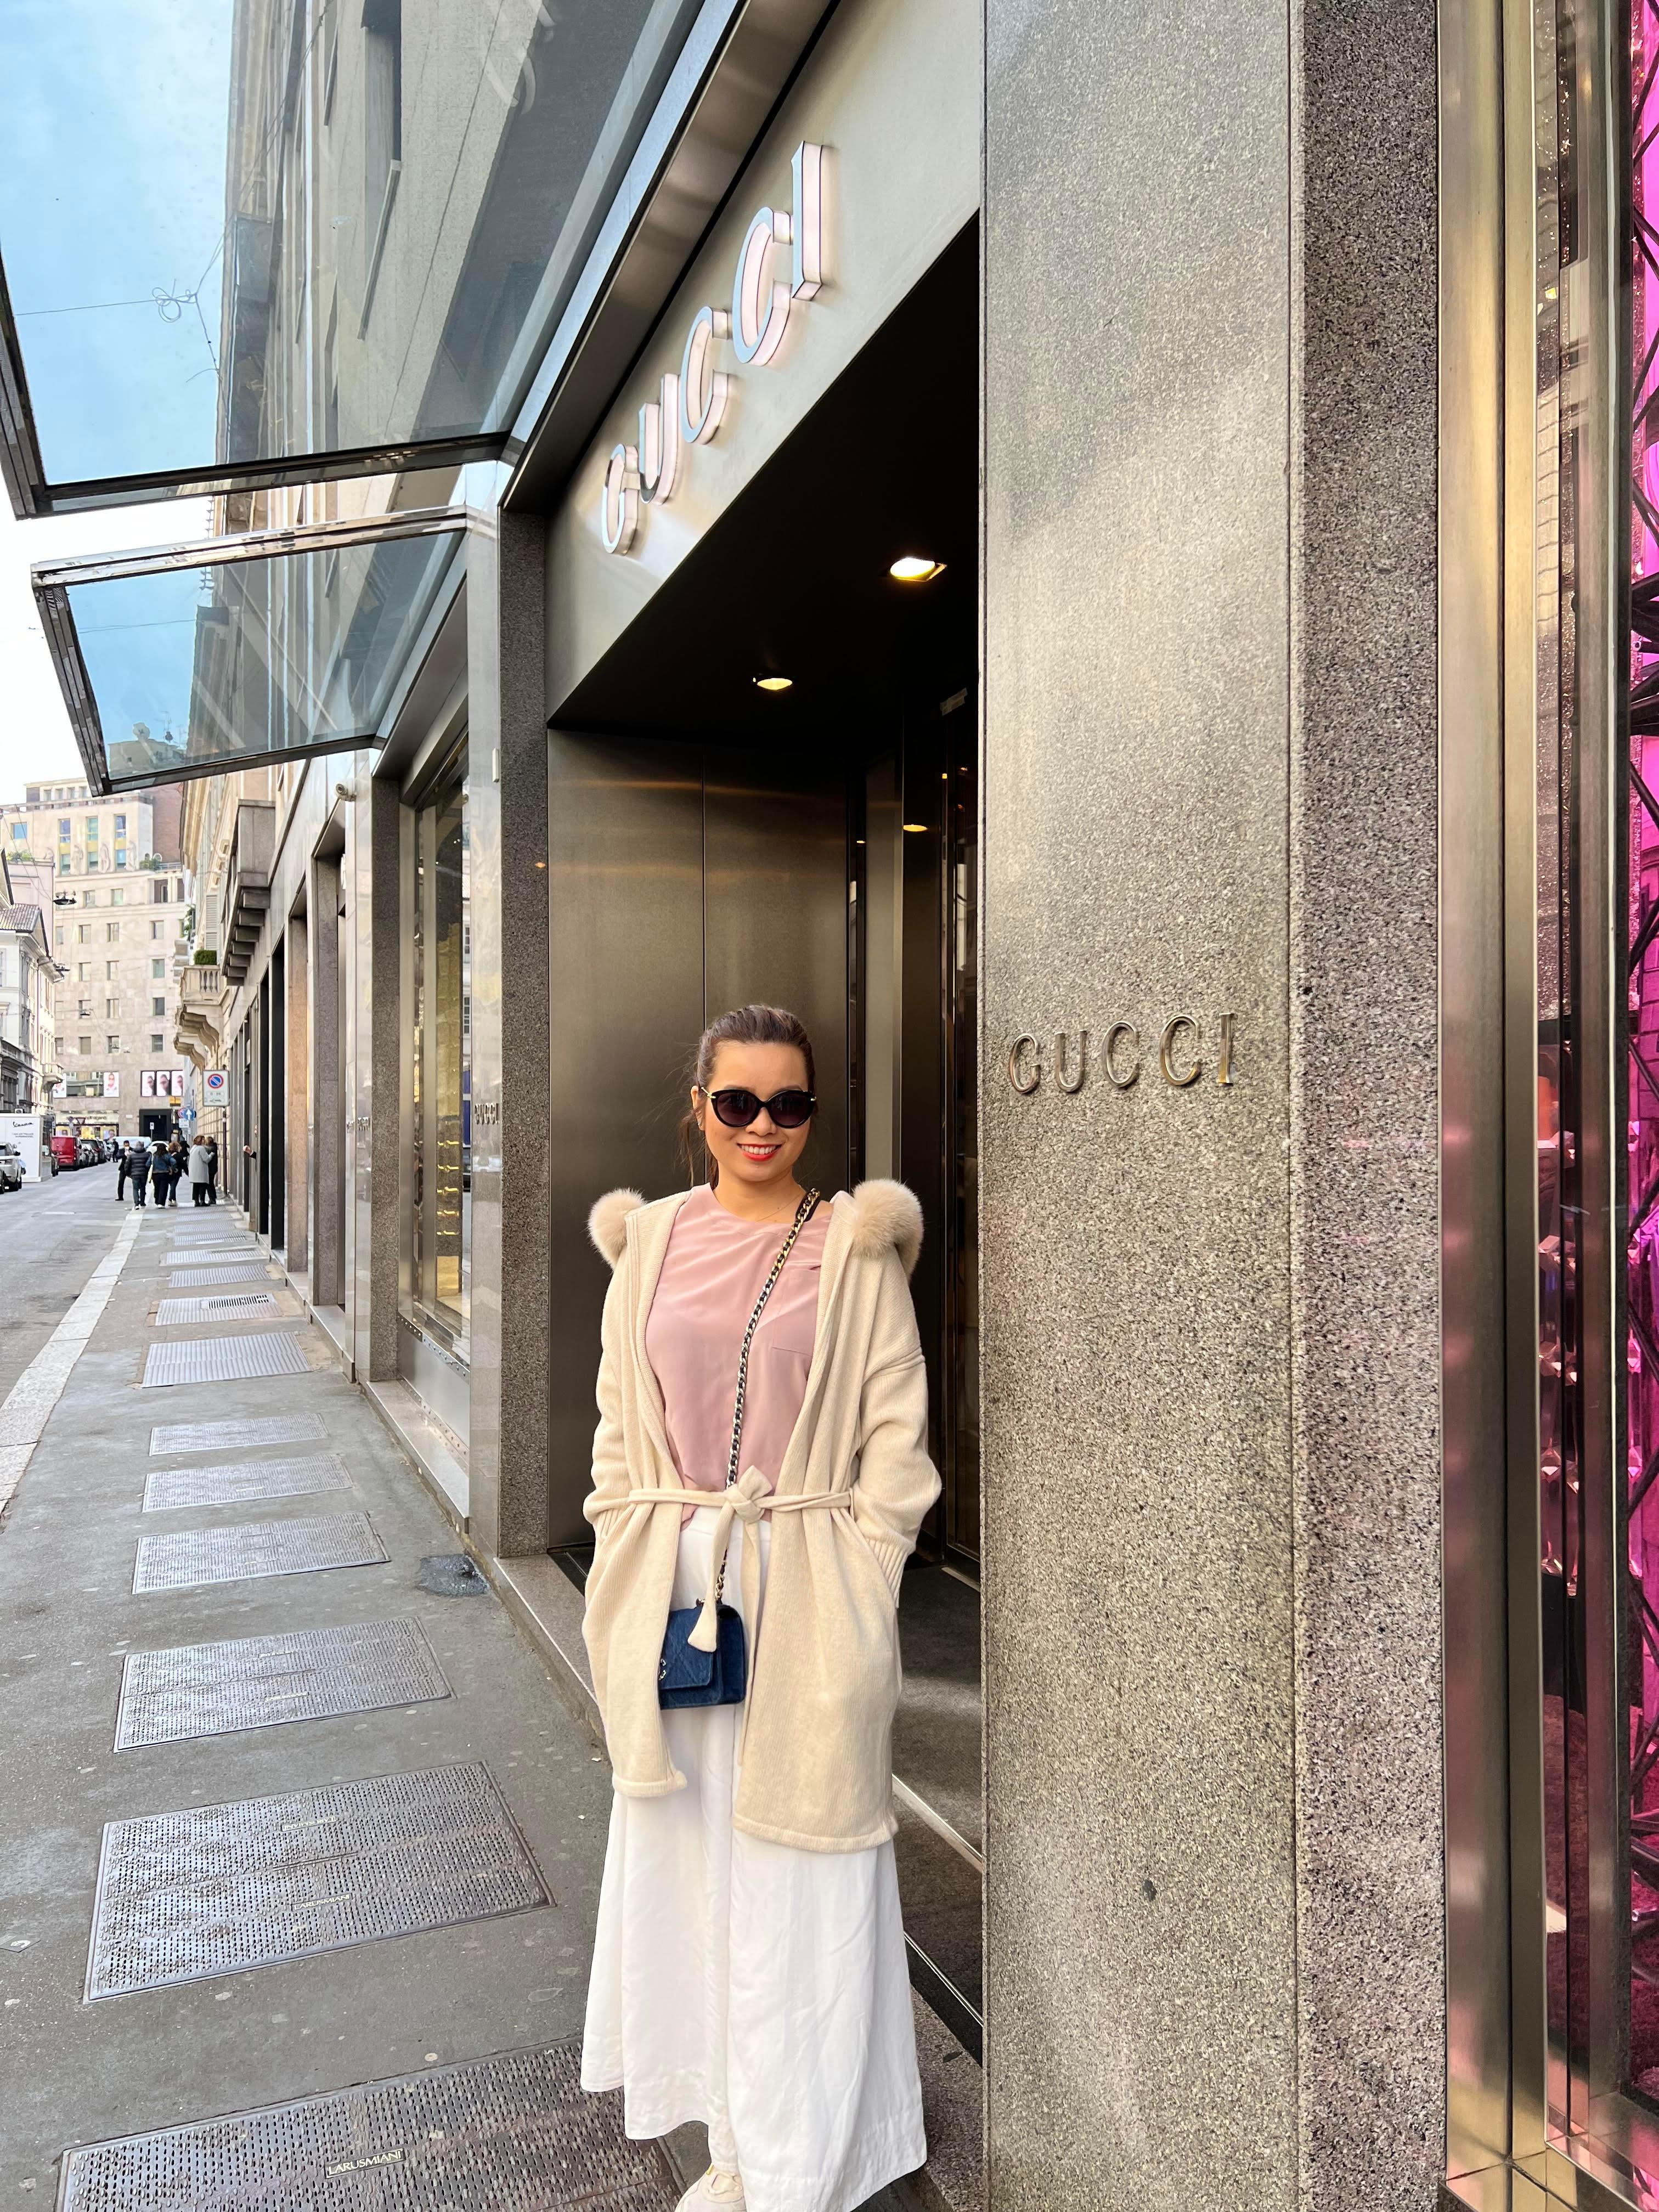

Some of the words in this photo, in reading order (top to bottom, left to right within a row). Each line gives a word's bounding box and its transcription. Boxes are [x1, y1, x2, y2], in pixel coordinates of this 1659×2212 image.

[602, 140, 822, 556] GUCCI
[1008, 1013, 1235, 1094] GUCCI
[294, 1894, 350, 1910] LARUSMIANI
[328, 2150, 402, 2175] LARUSMIANI
